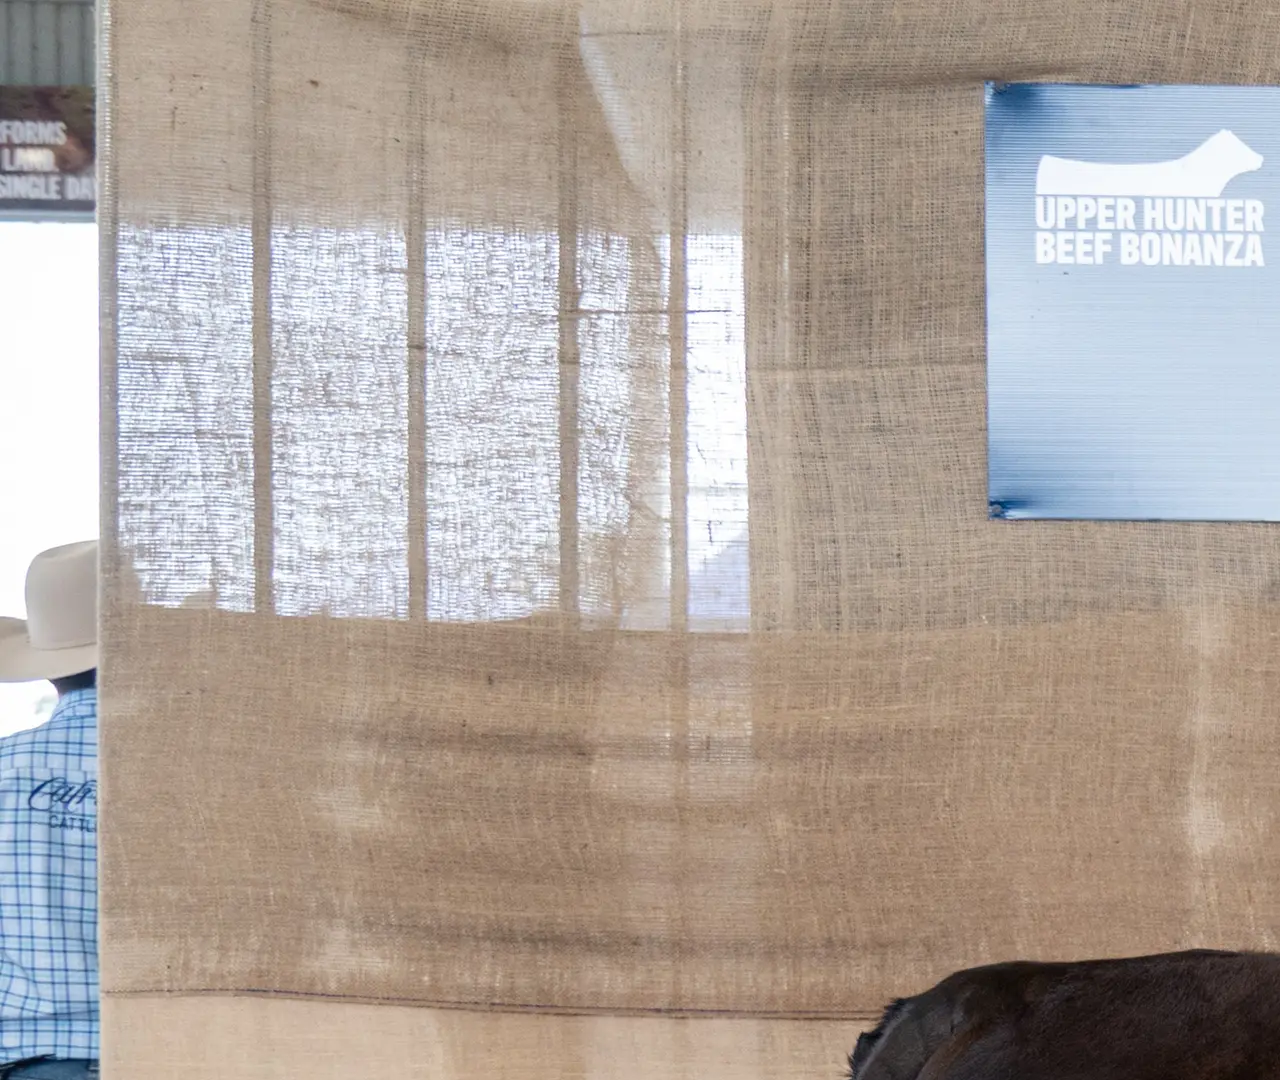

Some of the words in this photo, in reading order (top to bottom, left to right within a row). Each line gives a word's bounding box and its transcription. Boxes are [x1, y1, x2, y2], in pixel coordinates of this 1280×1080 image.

[1034, 197, 1136, 231] UPPER
[1143, 198, 1265, 233] HUNTER
[1034, 231, 1113, 265] BEEF
[1120, 231, 1265, 267] BONANZA
